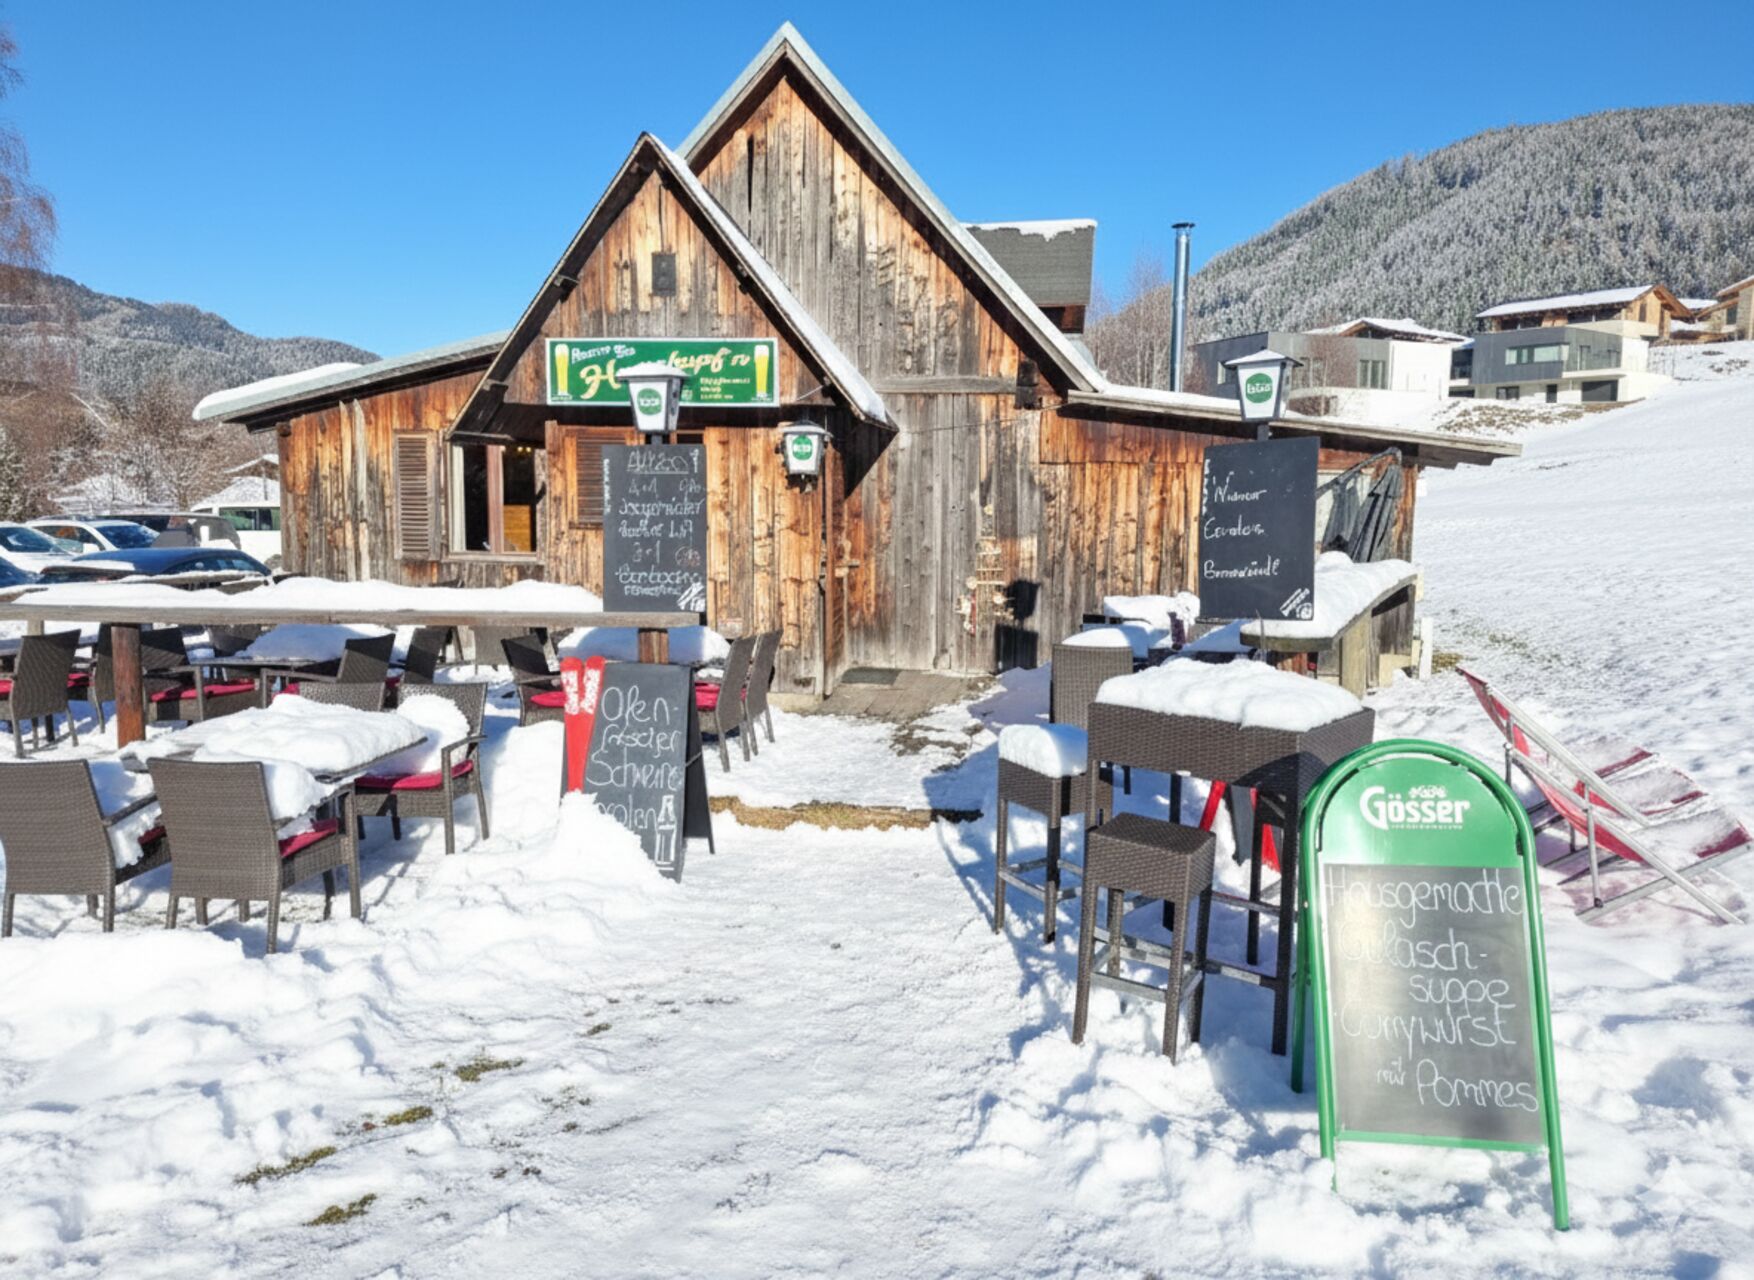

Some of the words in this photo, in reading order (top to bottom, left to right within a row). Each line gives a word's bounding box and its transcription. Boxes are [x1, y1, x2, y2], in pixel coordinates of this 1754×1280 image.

[1359, 785, 1471, 831] Gösser
[1324, 866, 1526, 928] Hausgemachte
[1408, 974, 1510, 1018] suppe
[1340, 1001, 1517, 1060] Currywurst
[1416, 1058, 1539, 1112] Pommes
